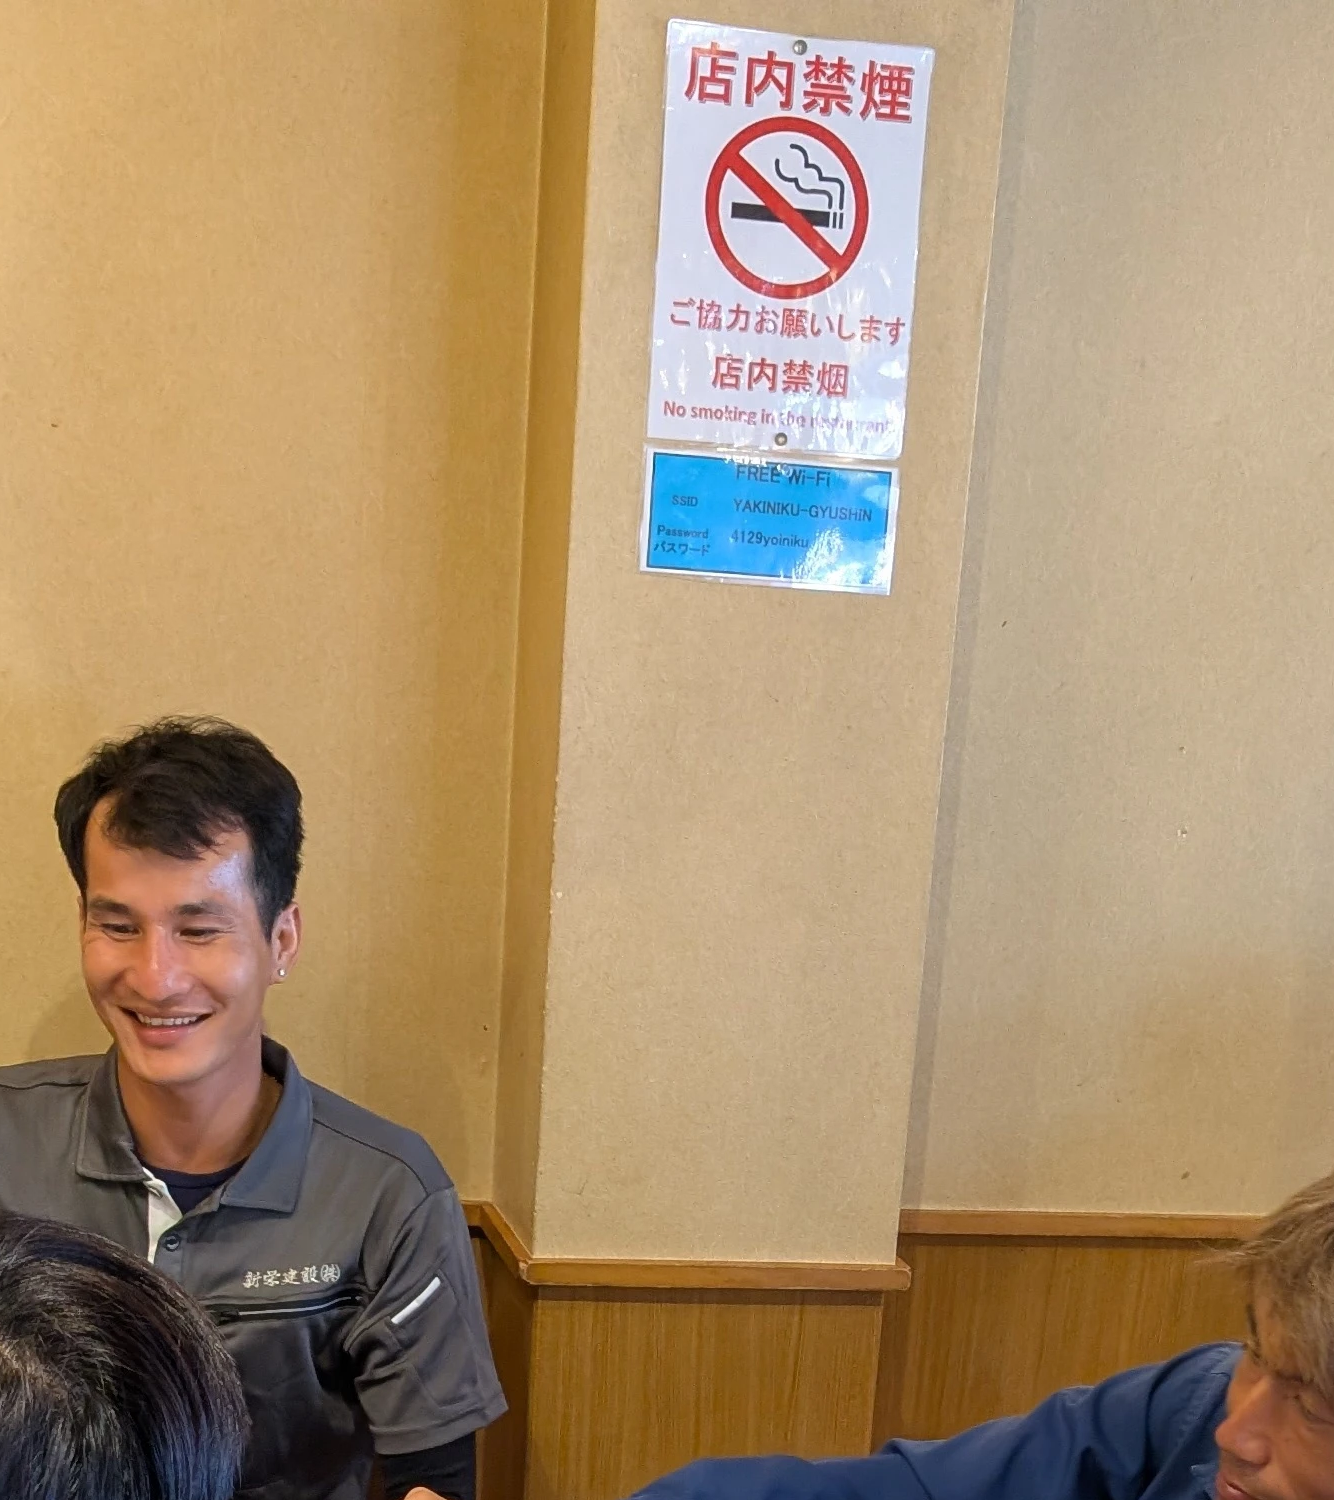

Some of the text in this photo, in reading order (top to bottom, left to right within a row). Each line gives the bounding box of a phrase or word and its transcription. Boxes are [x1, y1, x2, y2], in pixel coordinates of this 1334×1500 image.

[683, 41, 915, 124] 店内禁煙
[670, 298, 906, 346] ご協力お願いします
[711, 353, 850, 399] 店内禁烟
[663, 401, 686, 418] No
[690, 404, 758, 427] smoking
[761, 408, 776, 425] in
[736, 464, 831, 487] FREE Wi-Fi
[671, 494, 873, 523] SSID YAKINIKU-GYUSHIN
[656, 524, 709, 539] Password
[653, 540, 711, 557] パスワード
